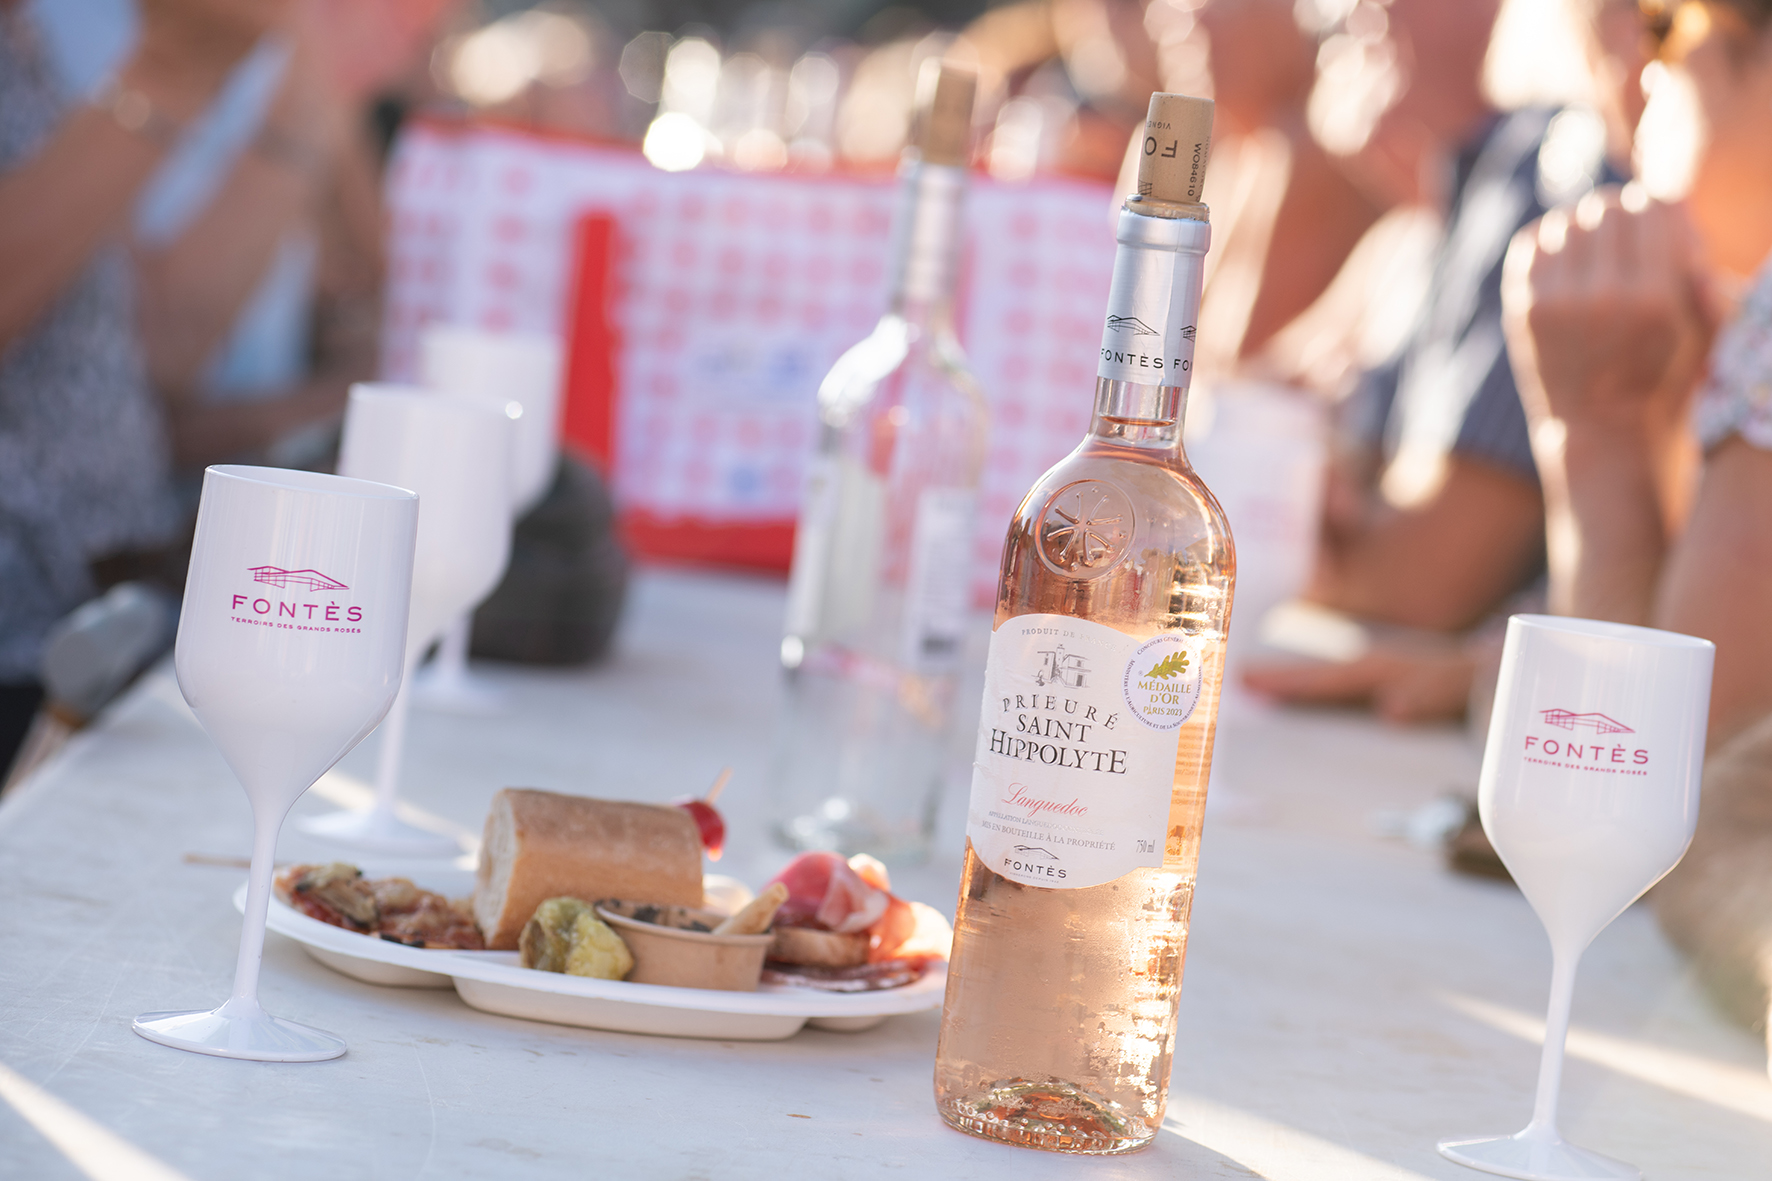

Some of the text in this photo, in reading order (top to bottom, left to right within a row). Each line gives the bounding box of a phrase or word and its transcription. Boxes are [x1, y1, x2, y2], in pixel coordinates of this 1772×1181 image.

[232, 594, 362, 622] FONTÈS
[231, 616, 273, 627] TERROIRS
[296, 625, 331, 633] GRANDS
[1021, 628, 1059, 636] PRODUIT
[1063, 630, 1075, 638] DE
[1137, 679, 1192, 694] MÉDAILLE
[1143, 704, 1183, 717] PARIS 2023
[1150, 693, 1180, 705] D'OR
[1002, 694, 1119, 730] PRIEURÉ
[1016, 713, 1092, 743] SAINT
[989, 728, 1127, 775] HIPPOLYTE
[1525, 736, 1649, 764] FONTÈS
[1524, 756, 1562, 767] TERROIRS
[1583, 765, 1617, 774] GRANDS
[1620, 768, 1648, 776] ROSÉS
[1001, 782, 1088, 818] Languedoc
[991, 823, 1001, 831] EN
[1001, 825, 1044, 841] BOUTEILLE
[1045, 832, 1052, 843] À
[1053, 835, 1065, 845] LA
[1066, 838, 1116, 851] PROPRIÉTÉ
[1004, 858, 1067, 879] FONTÈS
